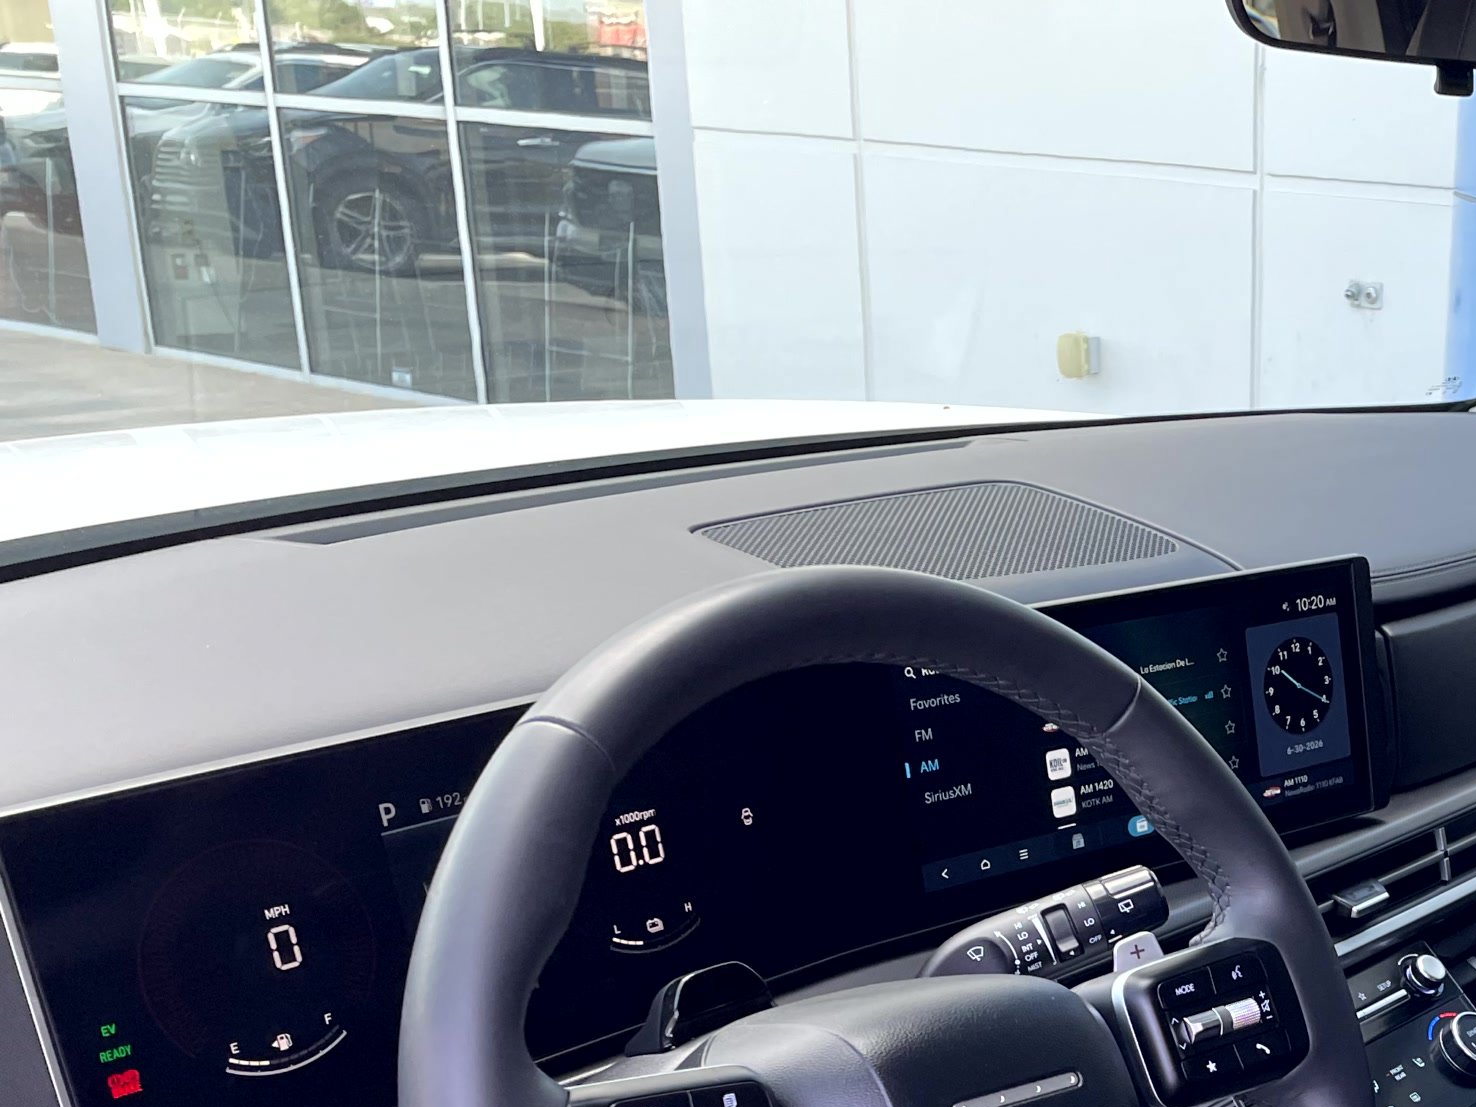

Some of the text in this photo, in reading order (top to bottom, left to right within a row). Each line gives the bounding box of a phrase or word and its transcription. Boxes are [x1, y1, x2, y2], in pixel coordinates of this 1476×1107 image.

[1295, 594, 1337, 612] 10:20 AM
[1291, 642, 1300, 652] 12
[1278, 650, 1288, 661] 11
[1317, 656, 1324, 666] 2
[1175, 658, 1185, 668] De
[1270, 665, 1281, 676] 10
[1323, 675, 1330, 685] 3
[1268, 686, 1275, 697] 9
[909, 693, 961, 711] Favorites
[1274, 704, 1281, 715] 8
[1312, 709, 1319, 719] 5
[1285, 715, 1291, 726] 7
[1300, 717, 1306, 727] 6
[914, 727, 933, 742] FM
[1075, 747, 1089, 758] AM
[920, 758, 940, 773] AM
[1080, 778, 1114, 795] AM 1420
[924, 782, 973, 805] SiriusXM
[435, 792, 463, 809] 192
[378, 802, 396, 827] P
[614, 808, 657, 826] x1000rpm
[610, 824, 665, 873] 0.0
[263, 904, 291, 920] MPH
[684, 901, 693, 913] H
[1083, 917, 1096, 928] LO
[613, 924, 622, 935] L
[1017, 931, 1029, 941] LO
[1088, 934, 1103, 944] OFF
[267, 924, 303, 971] 0
[1021, 943, 1034, 954] INT
[1024, 951, 1039, 962] OFF
[1027, 961, 1043, 972] MIST
[1175, 982, 1196, 997] MODE
[324, 1013, 333, 1025] F
[100, 1023, 116, 1037] EV
[99, 1044, 132, 1063] READY
[229, 1042, 240, 1055] E
